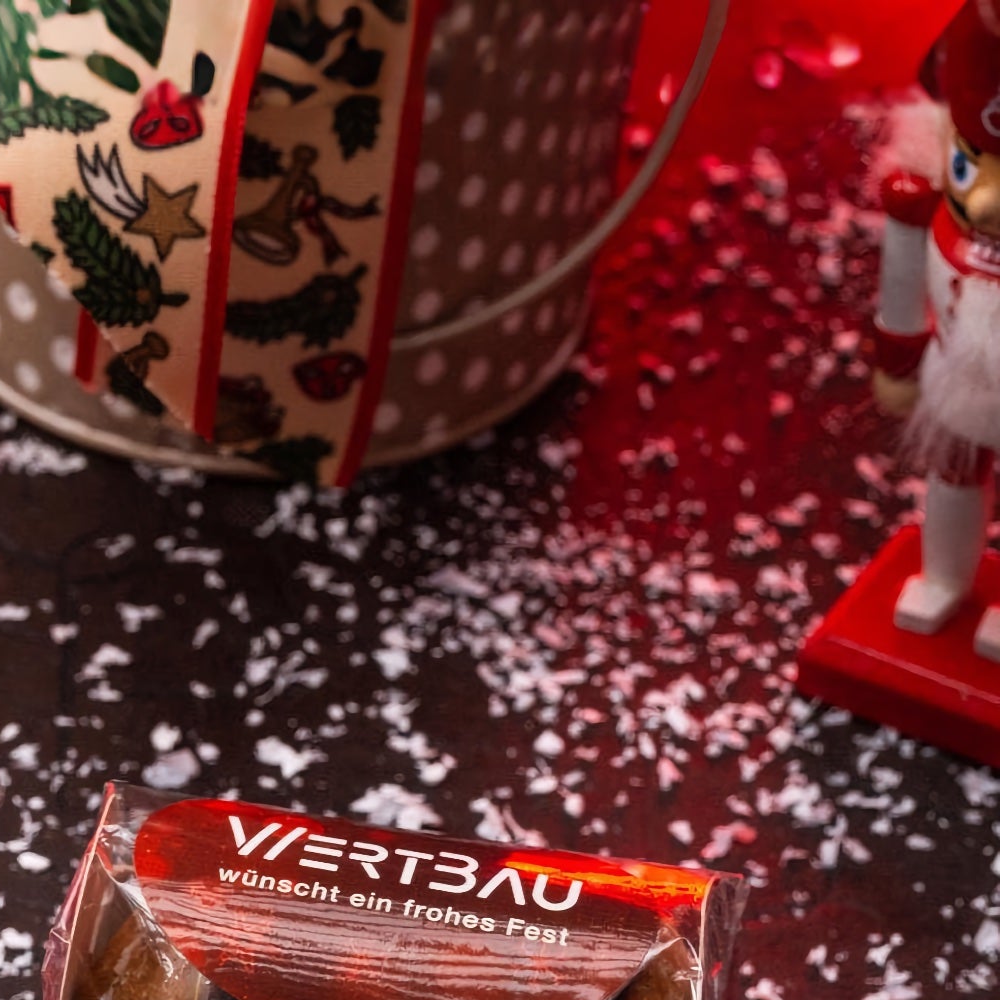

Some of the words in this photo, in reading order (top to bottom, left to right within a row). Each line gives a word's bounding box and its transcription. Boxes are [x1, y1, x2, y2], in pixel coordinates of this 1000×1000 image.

[218, 866, 341, 904] wünscht
[349, 891, 392, 913] ein
[402, 898, 496, 934] frohes
[505, 917, 570, 947] Fest
[227, 814, 584, 912] WERTBAU
